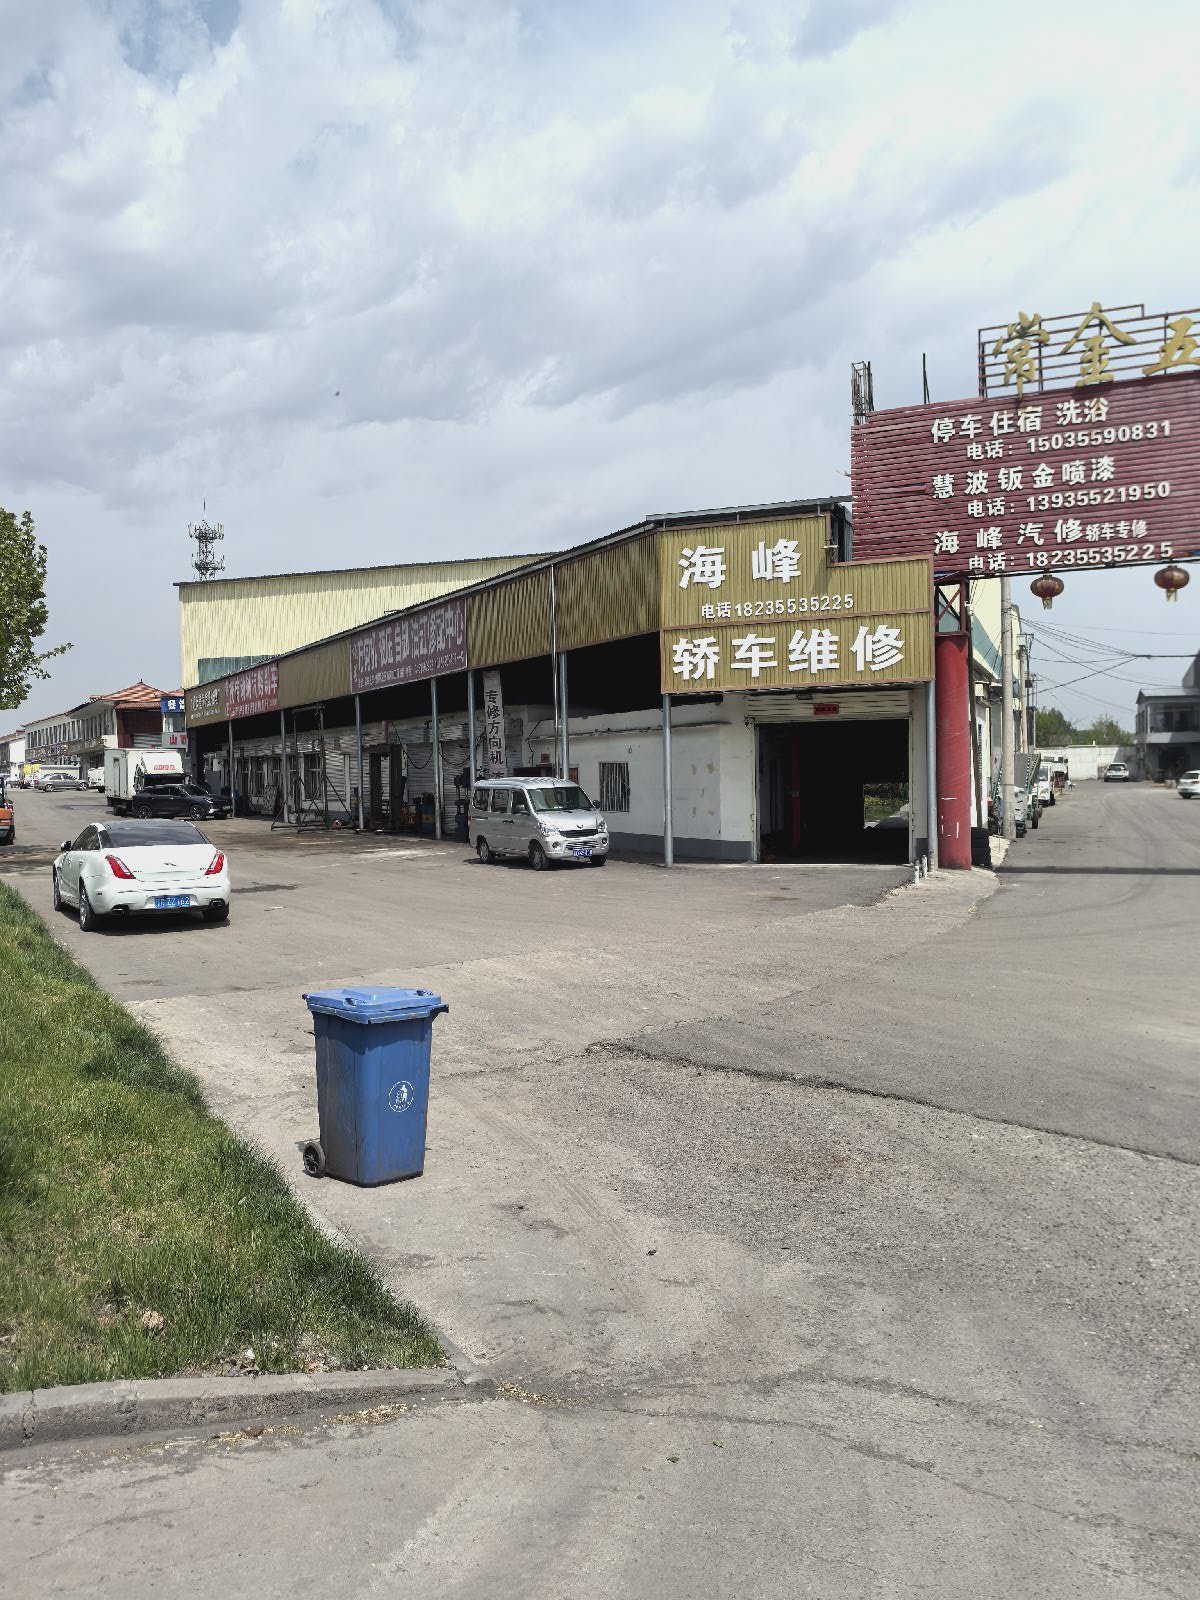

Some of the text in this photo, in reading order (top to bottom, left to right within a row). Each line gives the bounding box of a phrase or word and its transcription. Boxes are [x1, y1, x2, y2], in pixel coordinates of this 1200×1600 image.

[931, 397, 1109, 444] 停车住宿 洗浴
[932, 456, 1116, 499] 慧波钣金喷漆
[933, 518, 1083, 555] 海峰汽修
[678, 538, 802, 590] 海峰
[672, 624, 905, 680] 轿车维修
